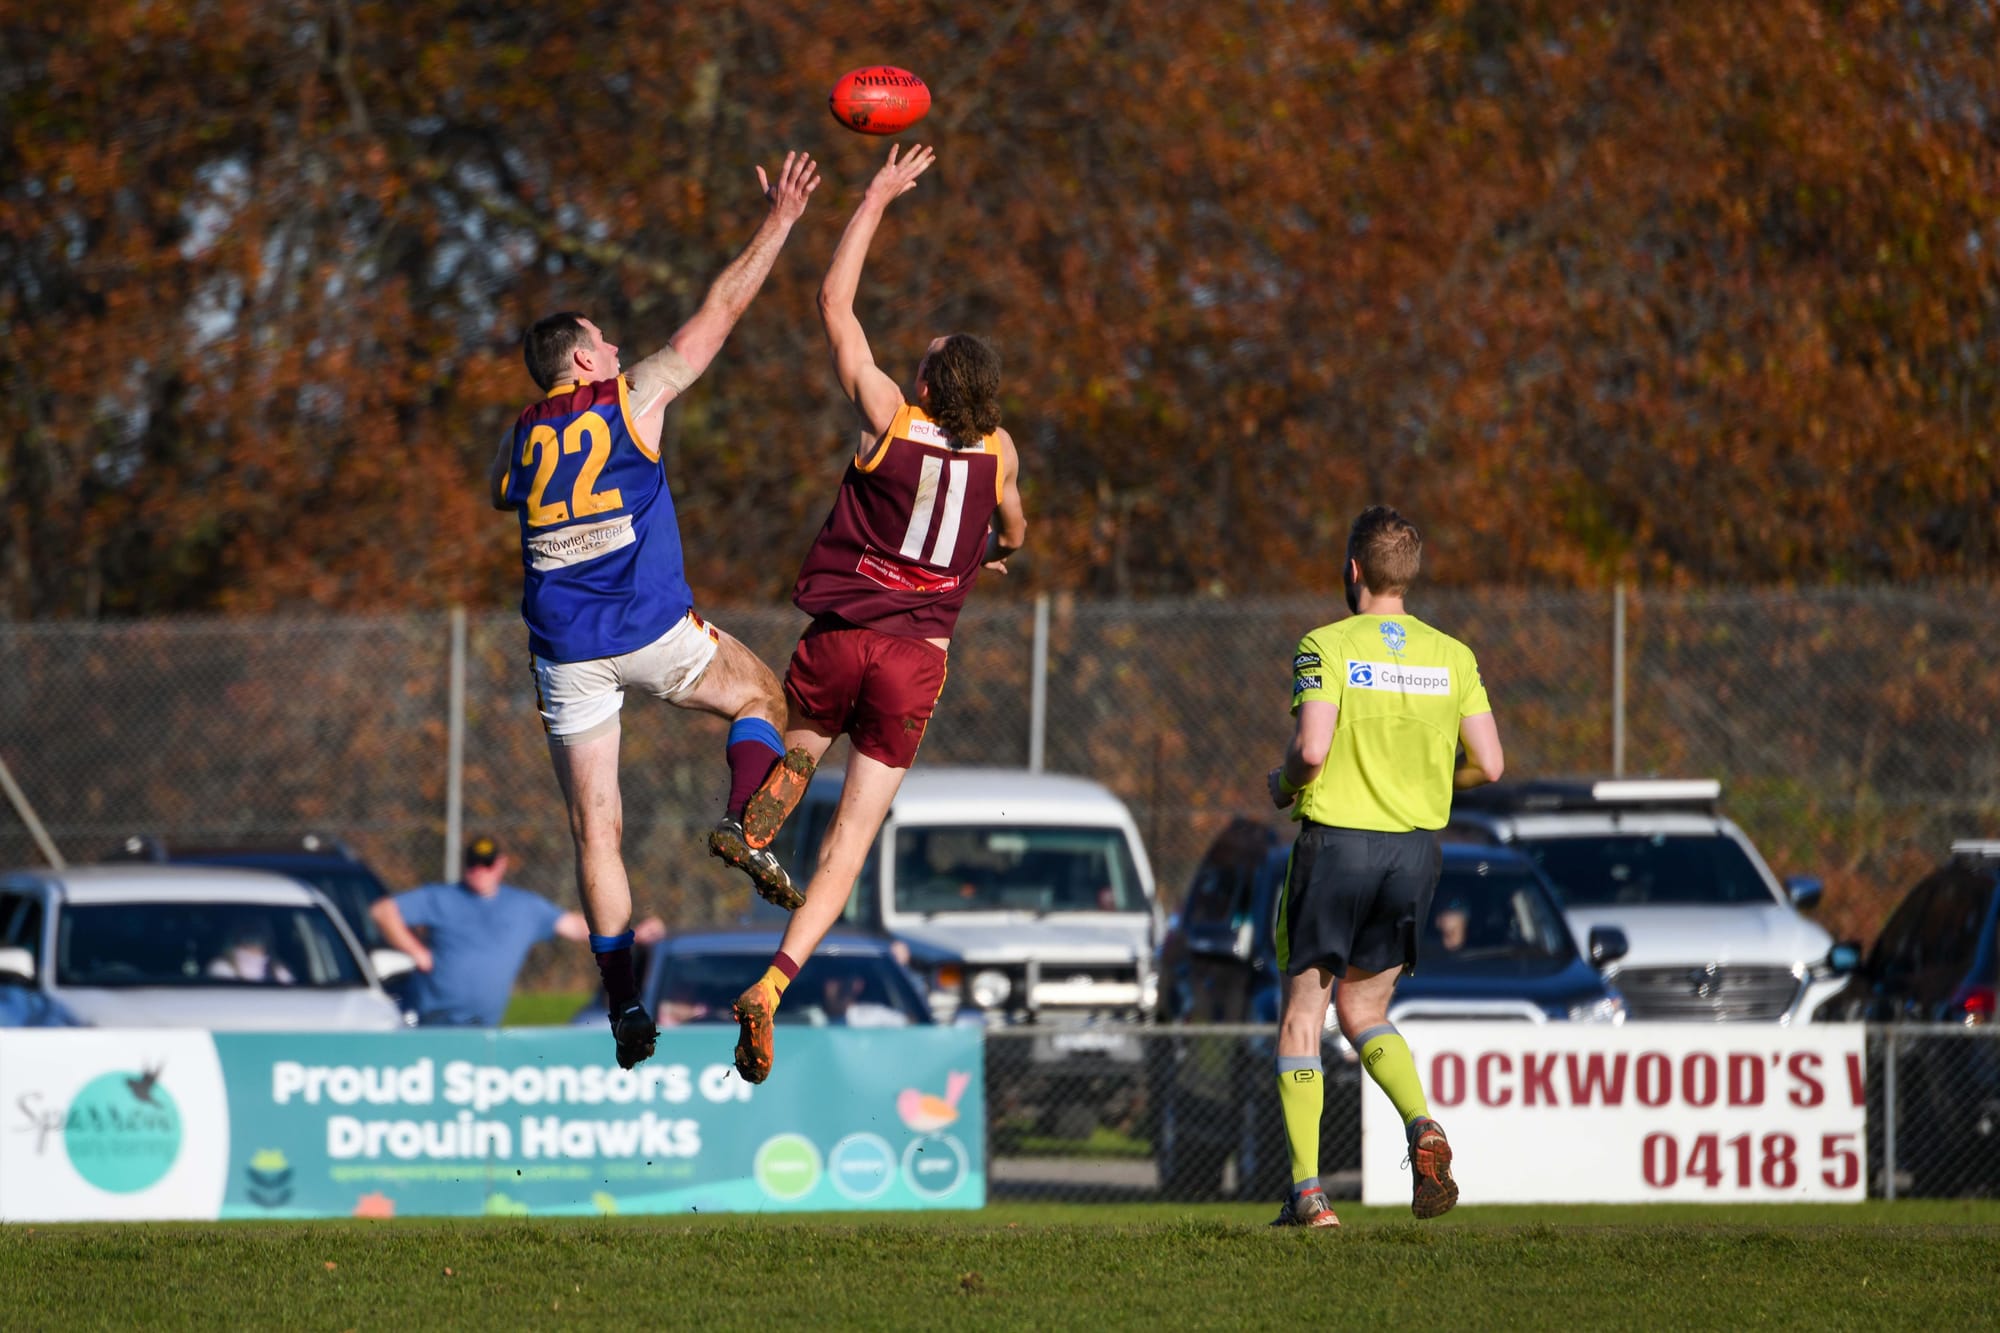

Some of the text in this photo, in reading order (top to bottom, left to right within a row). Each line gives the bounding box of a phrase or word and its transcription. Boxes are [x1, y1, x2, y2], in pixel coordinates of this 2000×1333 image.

[910, 424, 930, 435] red
[522, 411, 624, 527] 22
[899, 455, 969, 568] 11
[1381, 671, 1448, 689] Candappa
[272, 1056, 434, 1105] Proud
[443, 1059, 692, 1113] Sponsors
[1411, 1050, 1825, 1109] OCKWOOD'S
[327, 1110, 702, 1159] Drouin Hawks
[1641, 1131, 1859, 1189] 0418 5
